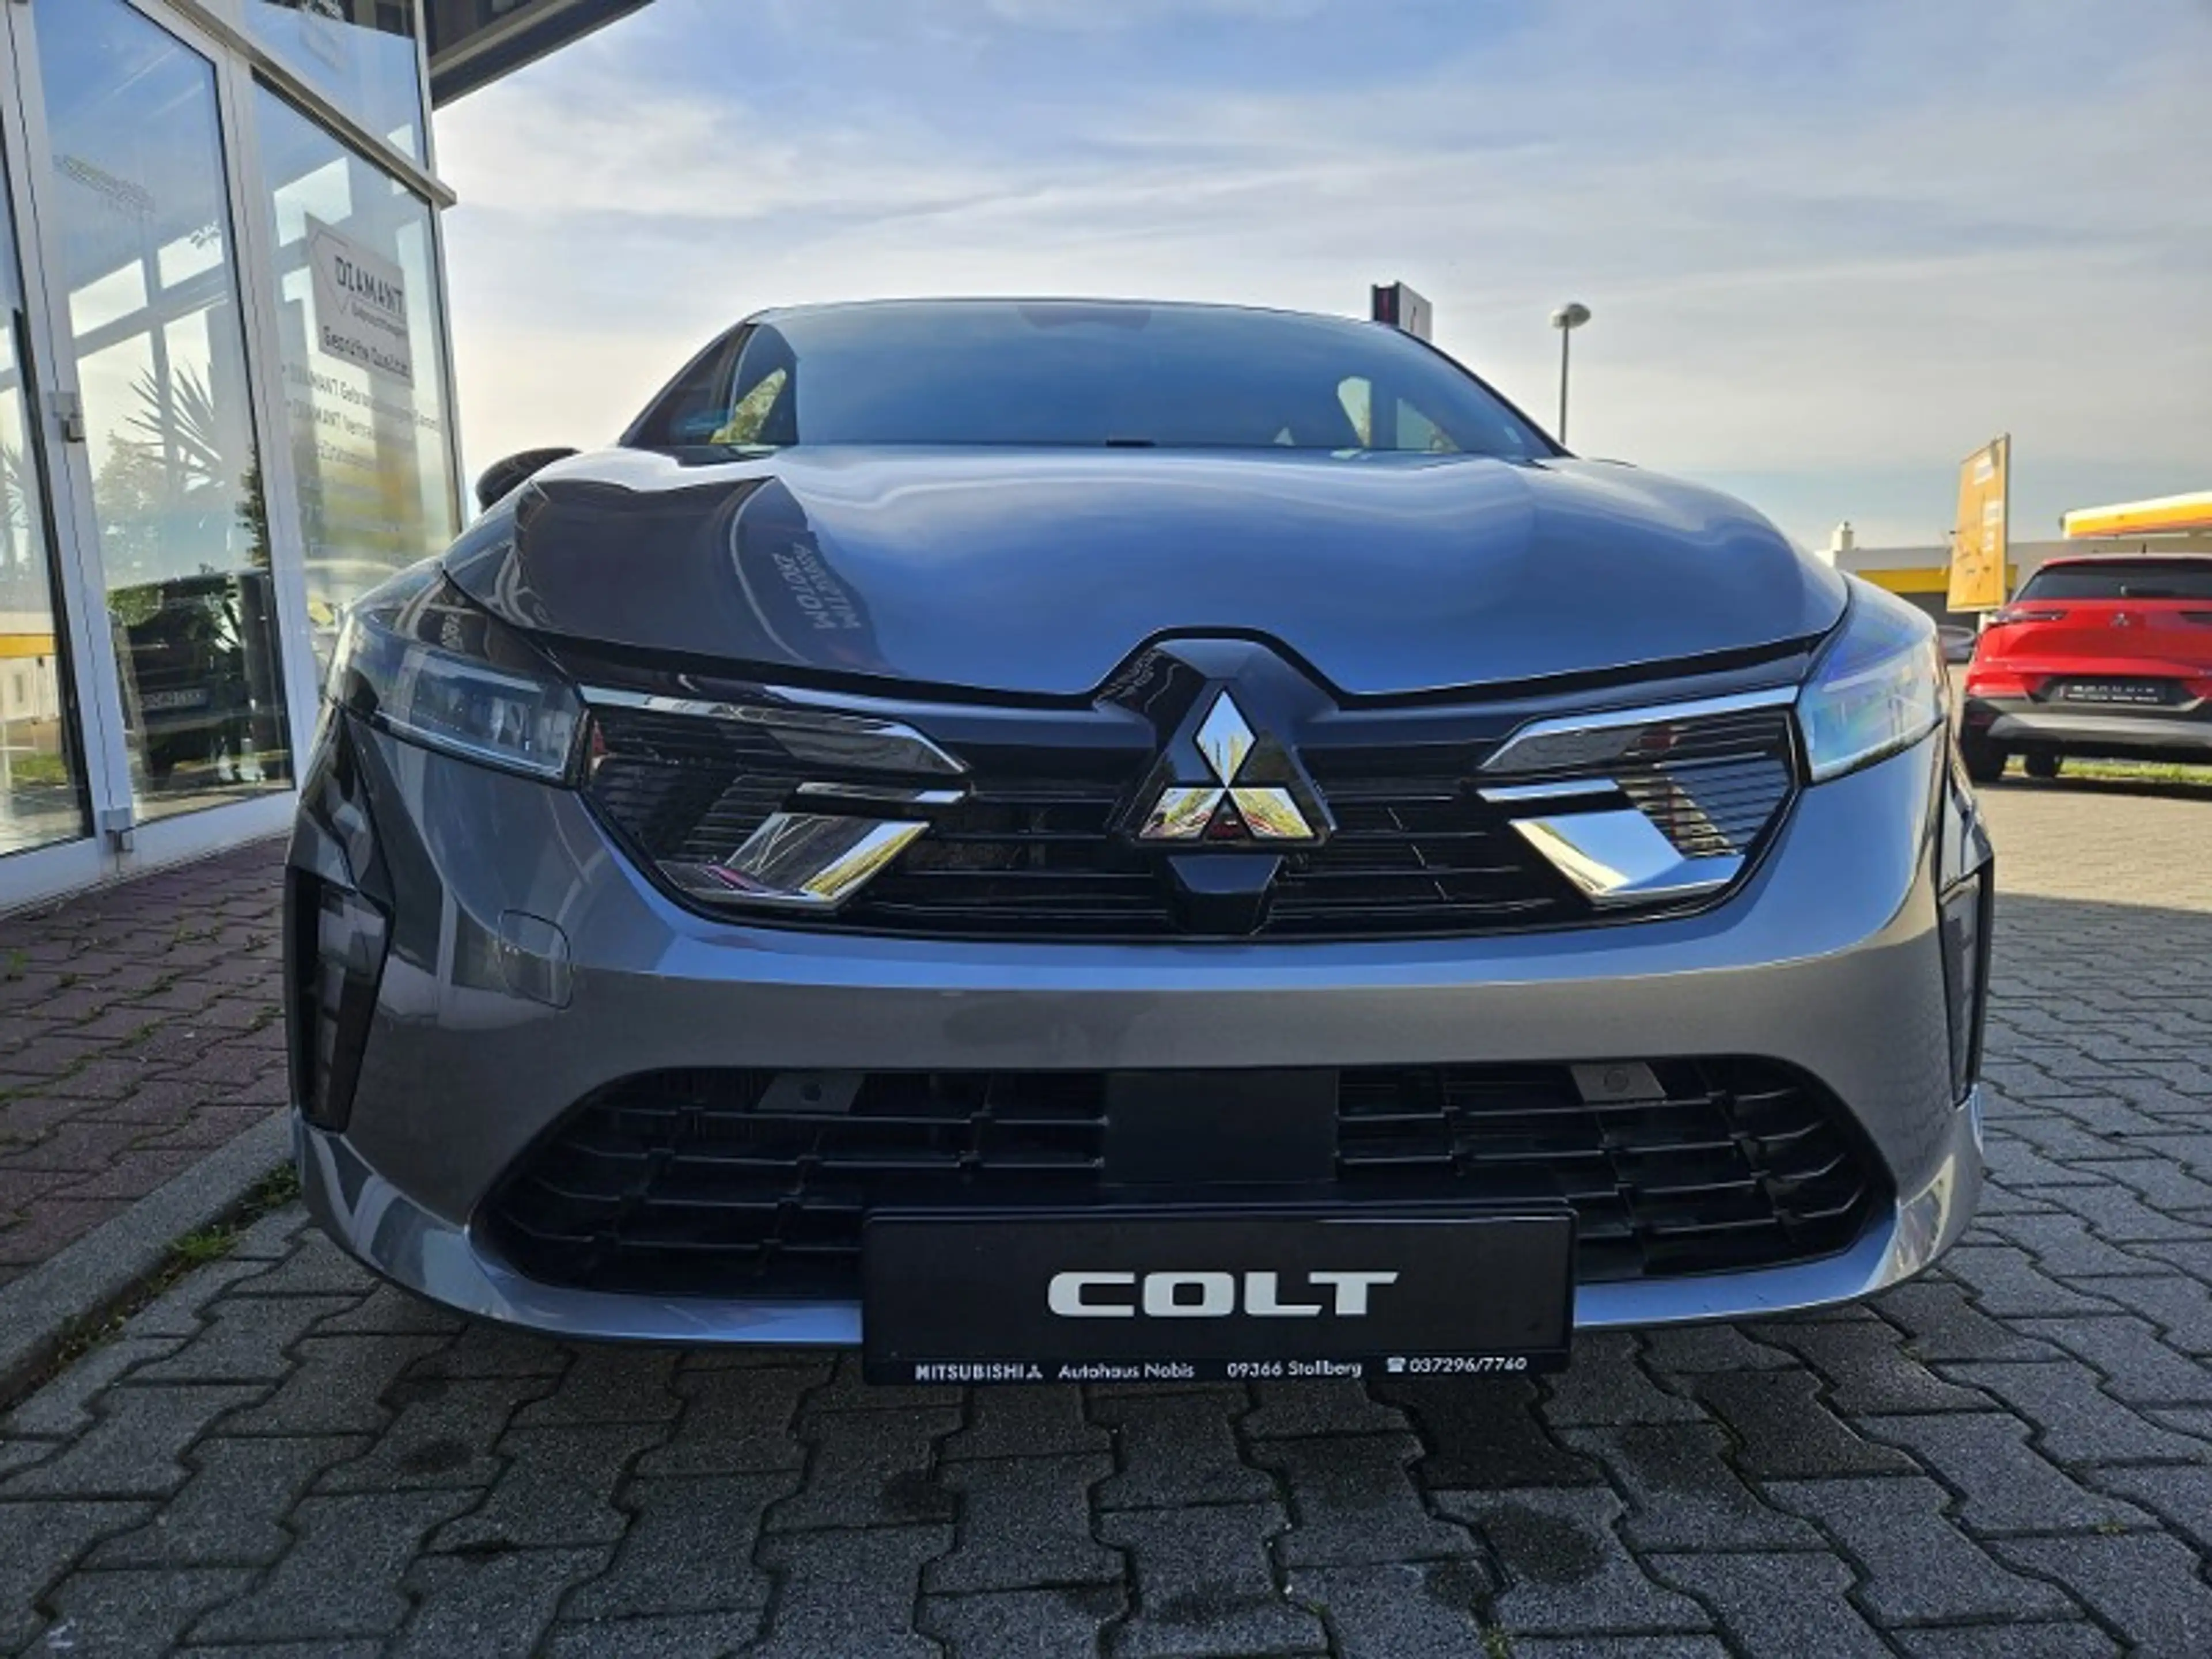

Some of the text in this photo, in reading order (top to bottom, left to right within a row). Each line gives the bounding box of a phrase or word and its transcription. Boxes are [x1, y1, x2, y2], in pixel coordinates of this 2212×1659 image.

[1047, 1271, 1399, 1317] COLT
[914, 1363, 1025, 1381] MITSUBISHI
[1058, 1362, 1141, 1380] Autohaus
[1143, 1361, 1195, 1378] Nobis
[1227, 1361, 1283, 1378] 09366
[1409, 1357, 1528, 1373] 037296/7760
